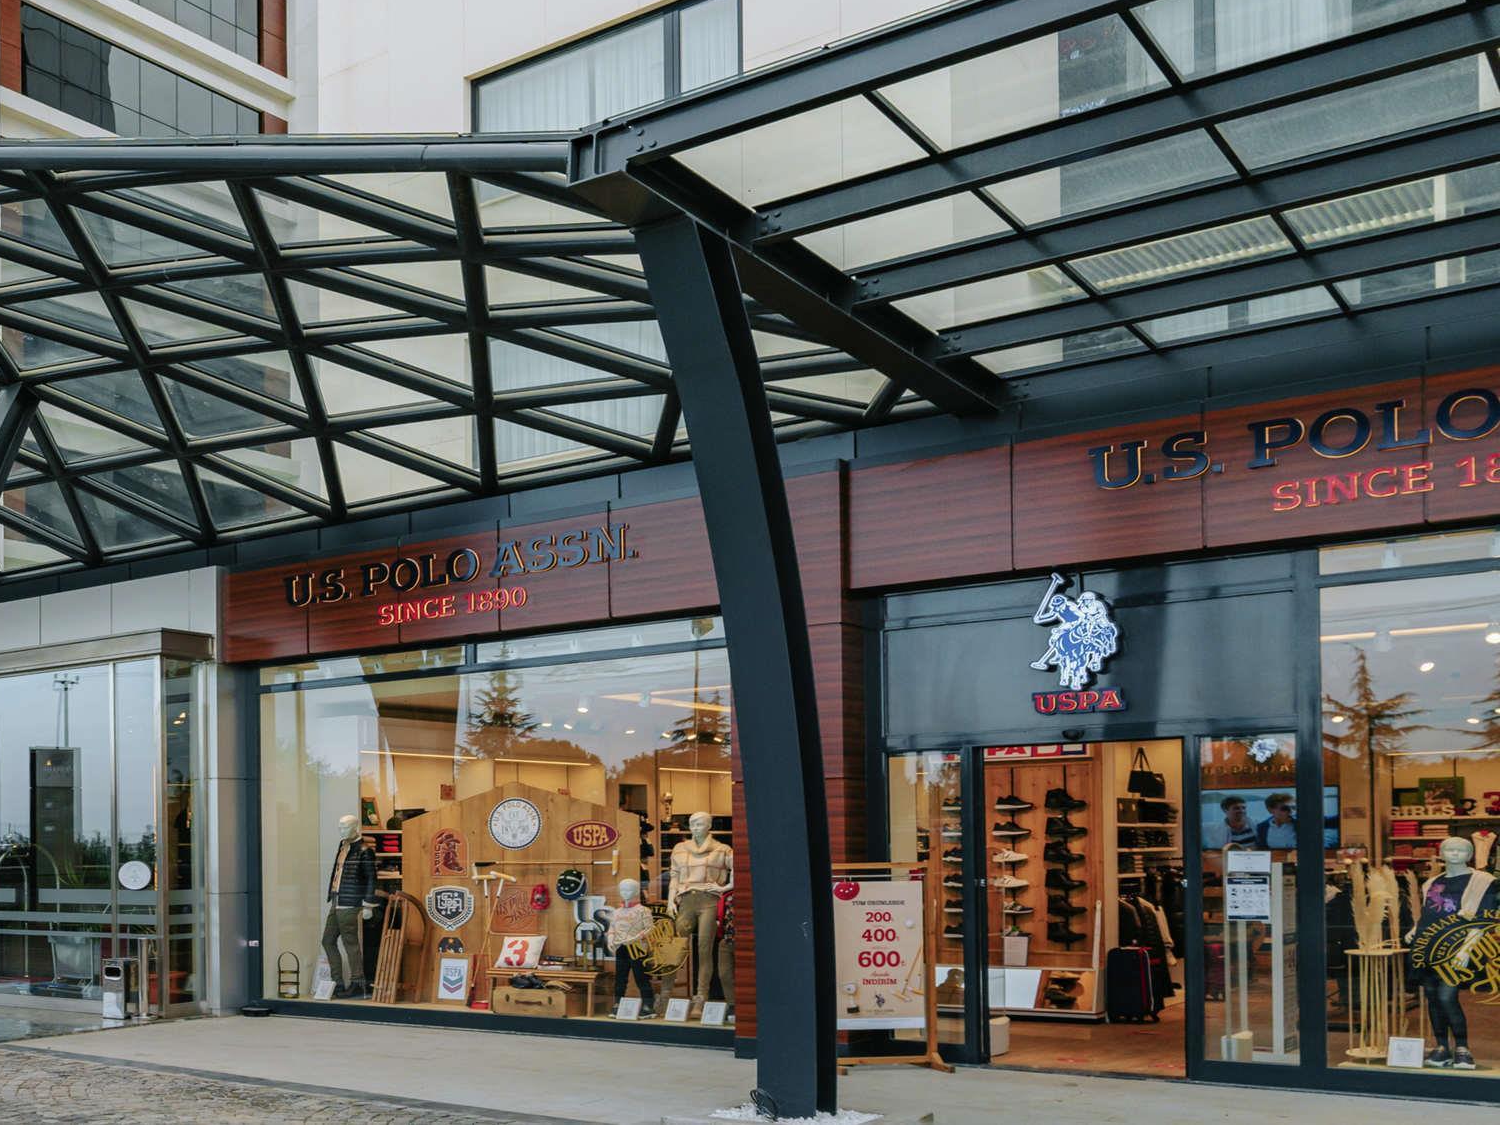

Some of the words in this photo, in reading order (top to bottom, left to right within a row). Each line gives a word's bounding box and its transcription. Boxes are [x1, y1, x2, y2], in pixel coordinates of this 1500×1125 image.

[1087, 431, 1225, 490] U.S.
[1247, 388, 1500, 471] POLO
[1271, 462, 1434, 512] SINCE
[284, 569, 352, 608] U.S.
[360, 548, 481, 597] POLO
[489, 523, 640, 578] ASSN.
[378, 595, 456, 626] SINCE
[466, 586, 527, 614] 1890
[1034, 690, 1122, 713] USPA
[572, 825, 609, 847] USPA
[1411, 914, 1461, 969] SONBAHAR
